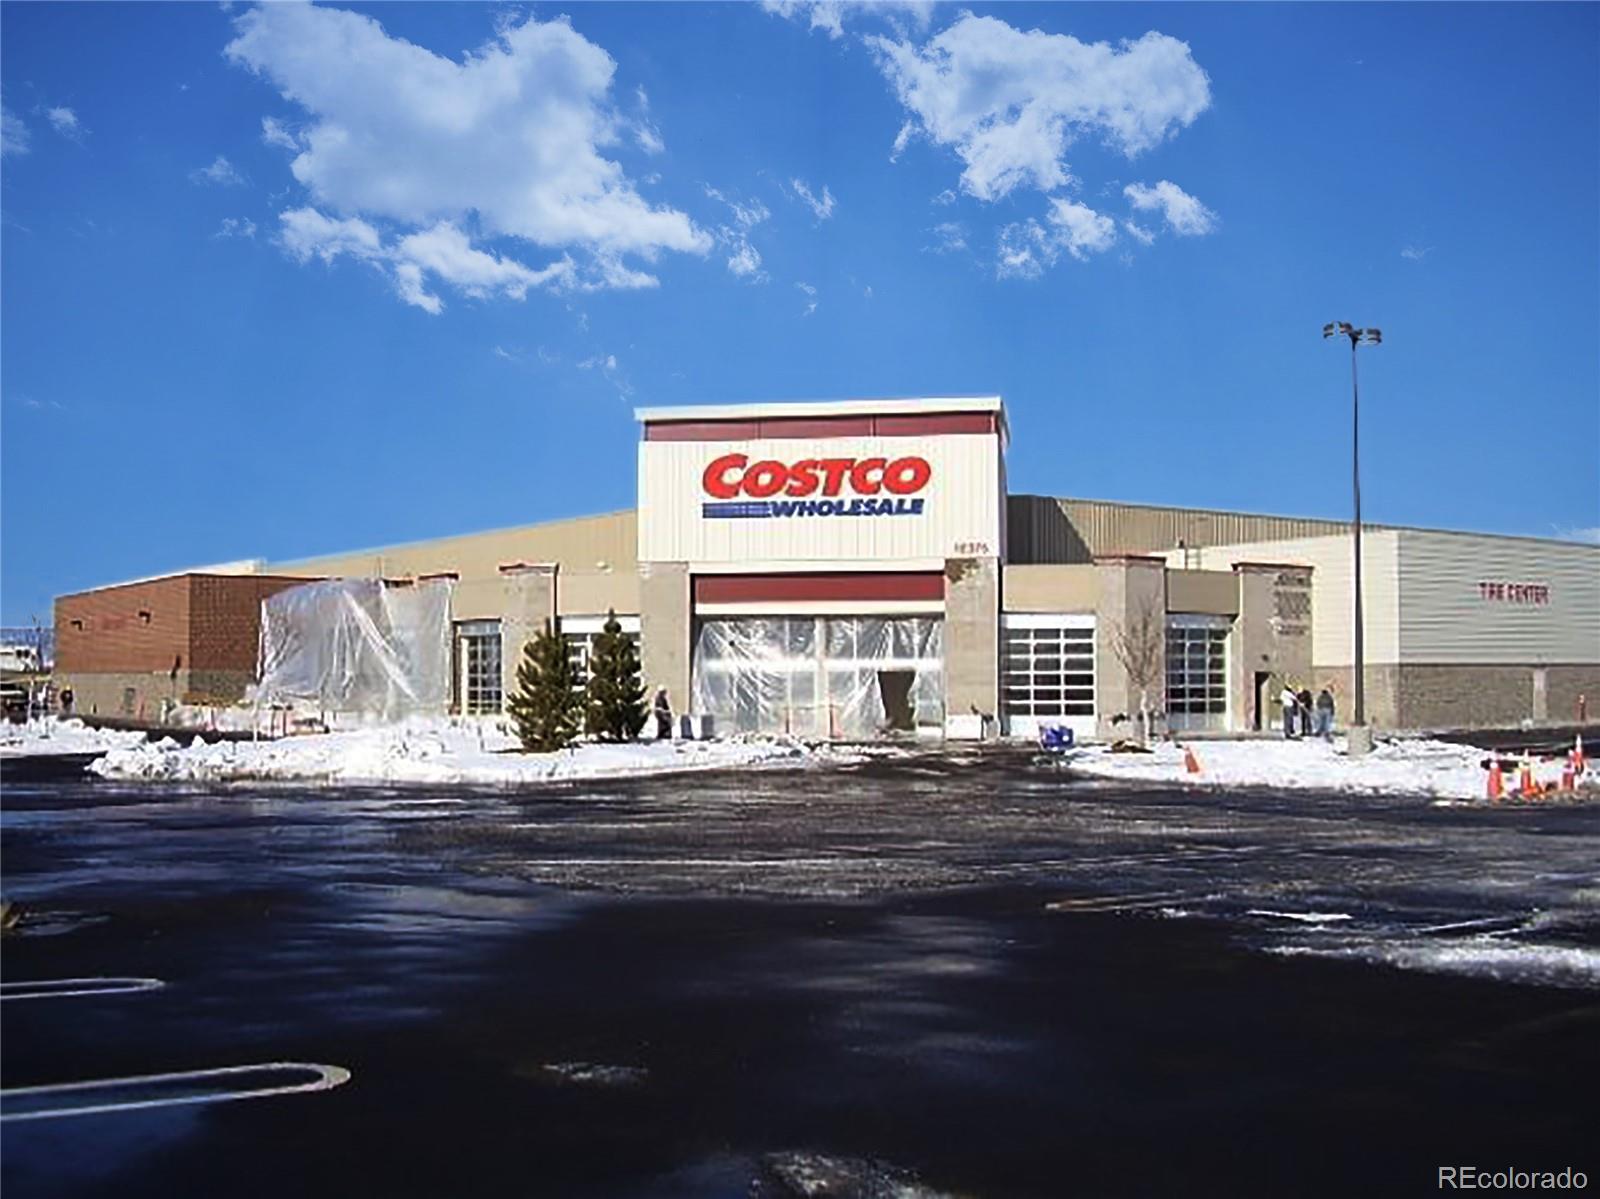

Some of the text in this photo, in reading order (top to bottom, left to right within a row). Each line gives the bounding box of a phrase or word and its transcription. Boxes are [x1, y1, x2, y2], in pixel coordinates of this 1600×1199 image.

[702, 453, 931, 499] COSTCO
[770, 498, 924, 517] WHOLESALE
[1508, 584, 1549, 604] CENTER
